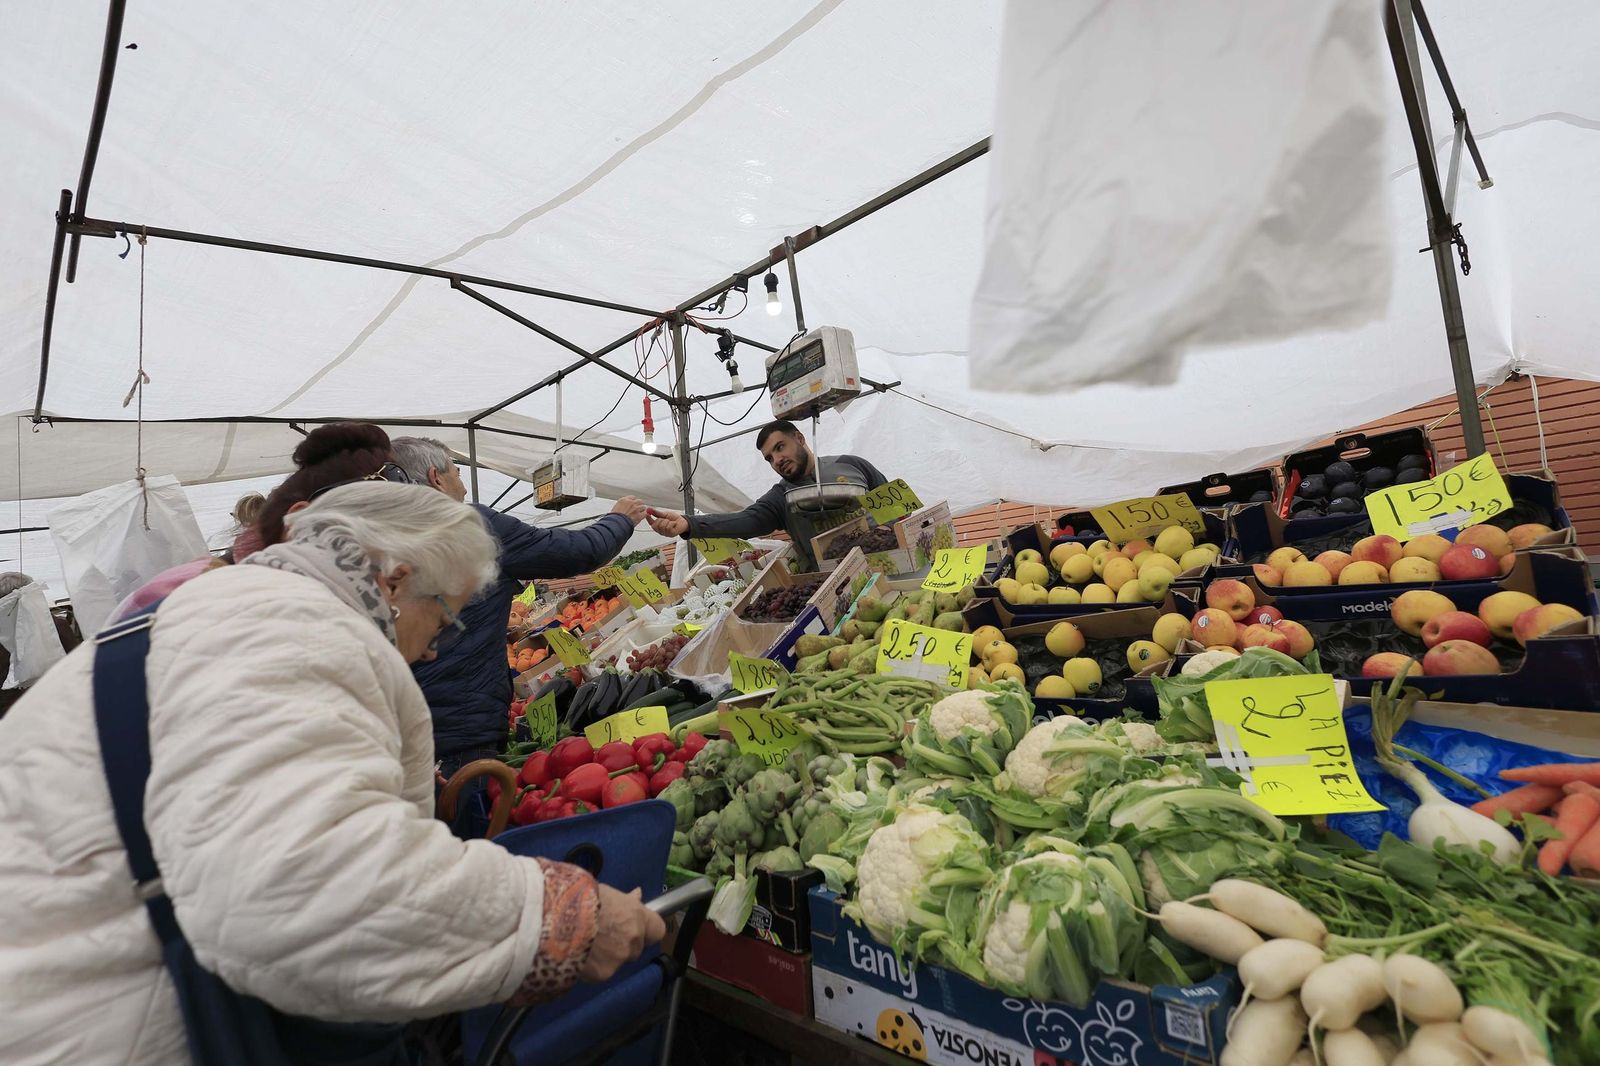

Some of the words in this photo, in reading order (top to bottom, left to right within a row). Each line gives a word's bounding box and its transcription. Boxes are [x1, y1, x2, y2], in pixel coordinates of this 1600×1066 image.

[1107, 500, 1170, 530] 1.50
[933, 552, 953, 579] 2
[964, 548, 974, 565] €
[954, 636, 966, 657] €
[635, 708, 648, 727] €
[847, 929, 918, 1000] tany
